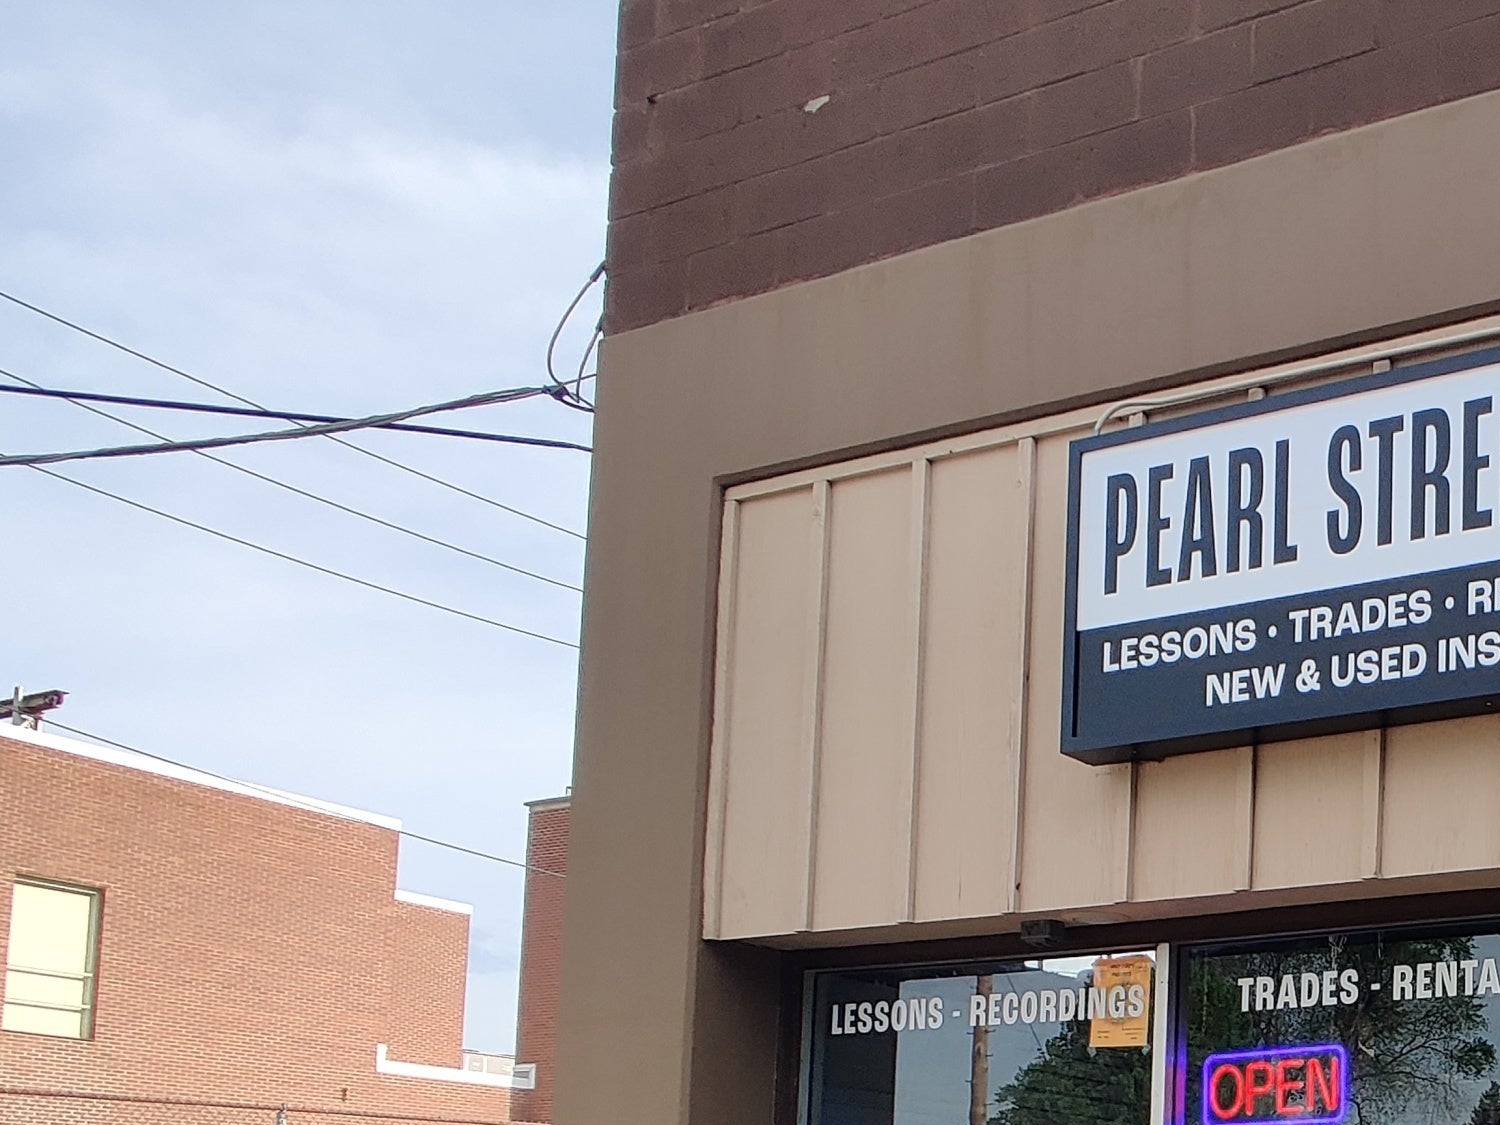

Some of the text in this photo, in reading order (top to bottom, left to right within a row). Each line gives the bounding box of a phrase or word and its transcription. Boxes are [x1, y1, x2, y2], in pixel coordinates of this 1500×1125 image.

[1104, 438, 1299, 596] PEARL
[1103, 620, 1257, 673] LESSONS
[1289, 590, 1433, 644] TRADES
[1205, 662, 1285, 707] NEW
[1295, 658, 1321, 692] &
[1331, 642, 1428, 687] USED
[831, 991, 943, 1035] LESSONS
[969, 984, 1146, 1027] RECORDINGS
[1238, 968, 1359, 1013] TRADES
[1208, 1055, 1340, 1120] OPEN
